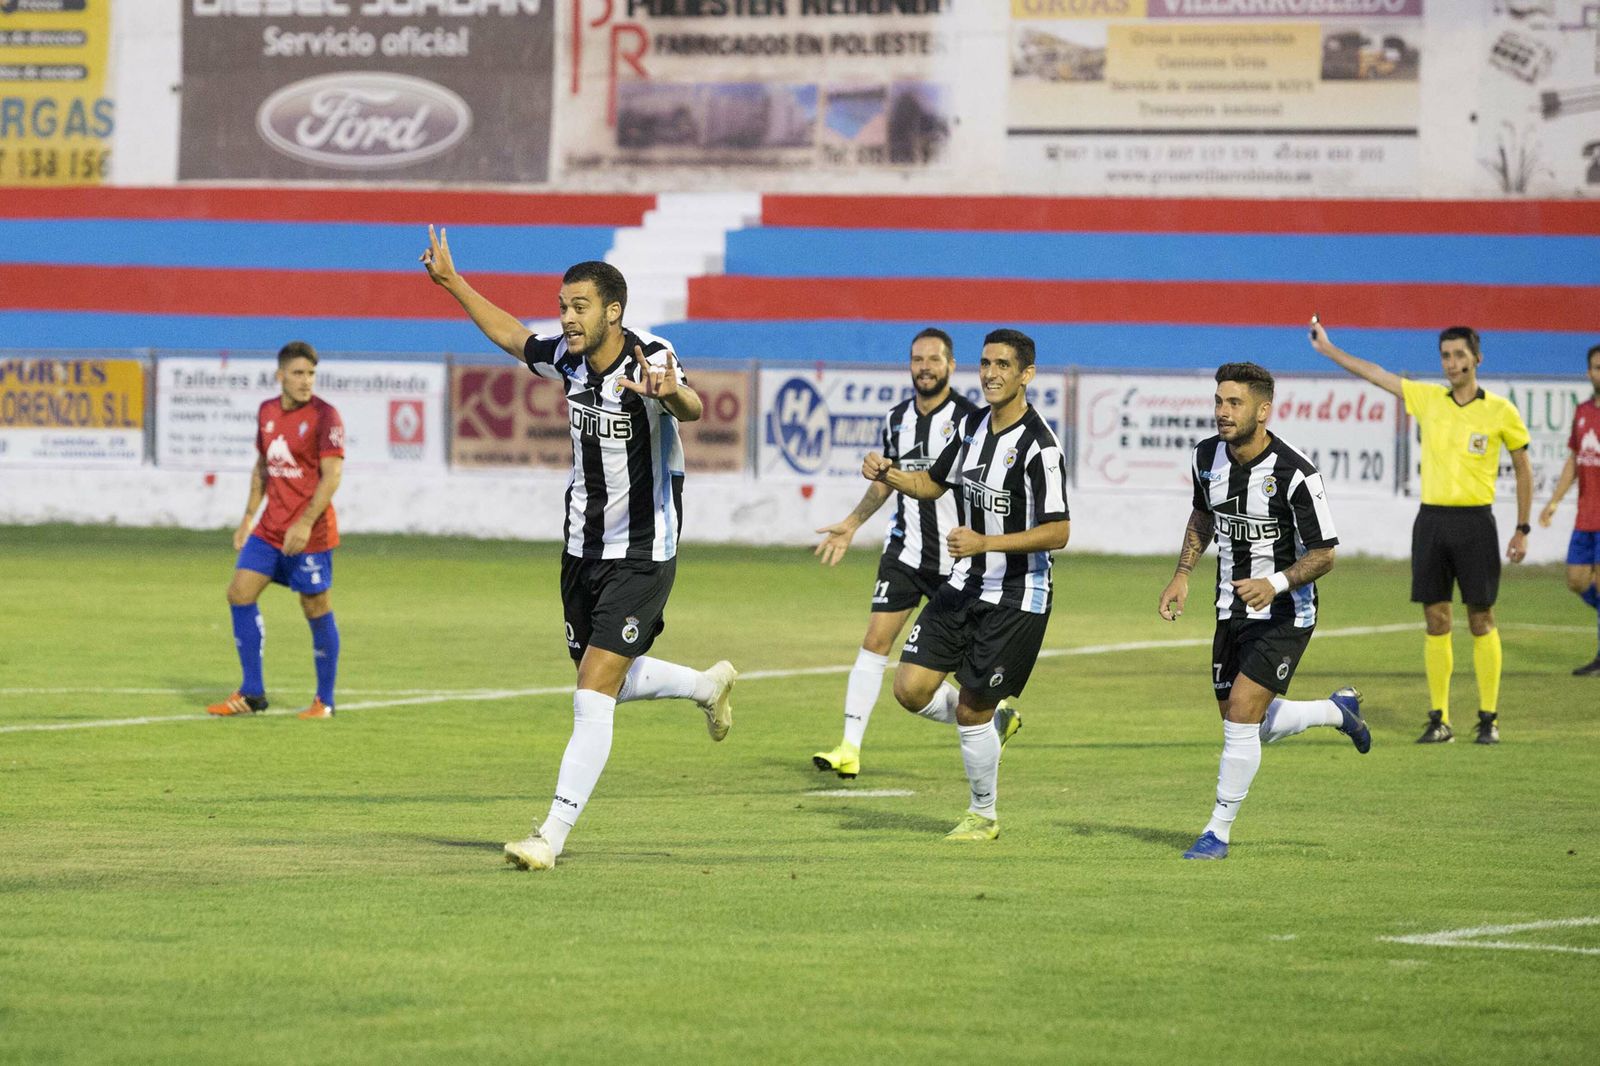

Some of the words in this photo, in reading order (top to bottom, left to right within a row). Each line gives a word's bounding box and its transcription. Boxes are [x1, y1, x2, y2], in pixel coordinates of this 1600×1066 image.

[263, 26, 376, 56] Servicio
[381, 26, 469, 56] oficial
[296, 88, 430, 148] Ford
[1277, 391, 1385, 422] óndola
[571, 406, 633, 440] OTUS
[1213, 663, 1222, 682] 7
